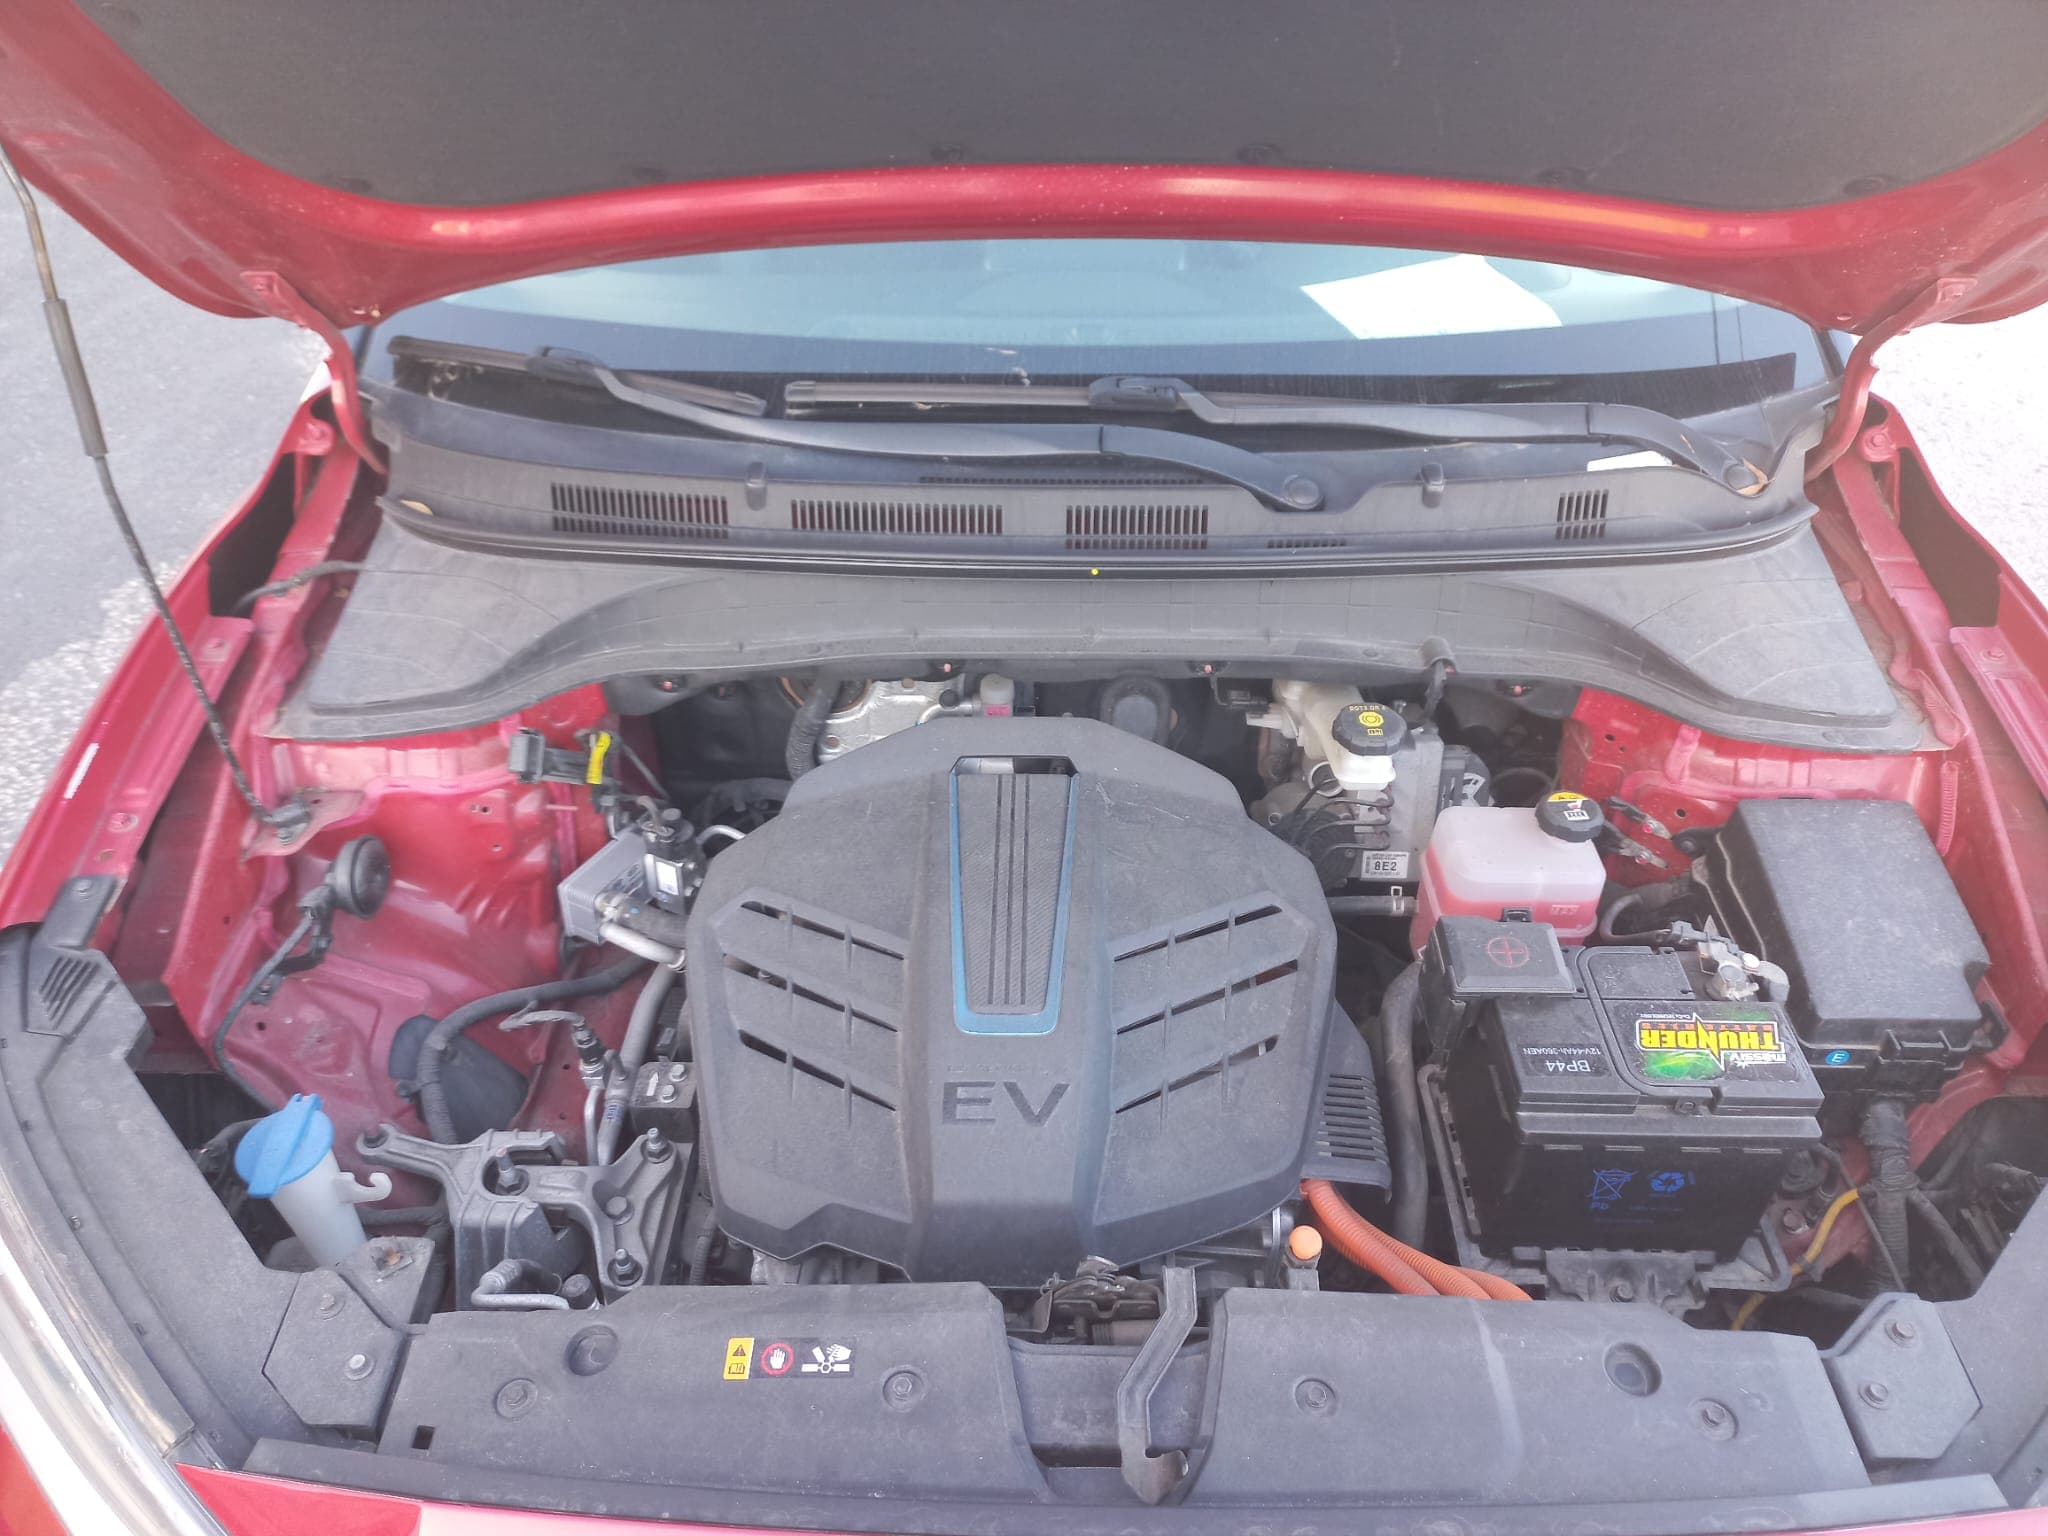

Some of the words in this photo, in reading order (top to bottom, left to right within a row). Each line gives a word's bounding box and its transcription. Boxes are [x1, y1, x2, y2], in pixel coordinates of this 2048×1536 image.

[1374, 861, 1397, 871] 8E2
[1640, 1024, 1779, 1055] THUNDER
[1831, 1053, 1846, 1063] E
[1545, 1060, 1592, 1072] BP44
[942, 1080, 1072, 1127] EV
